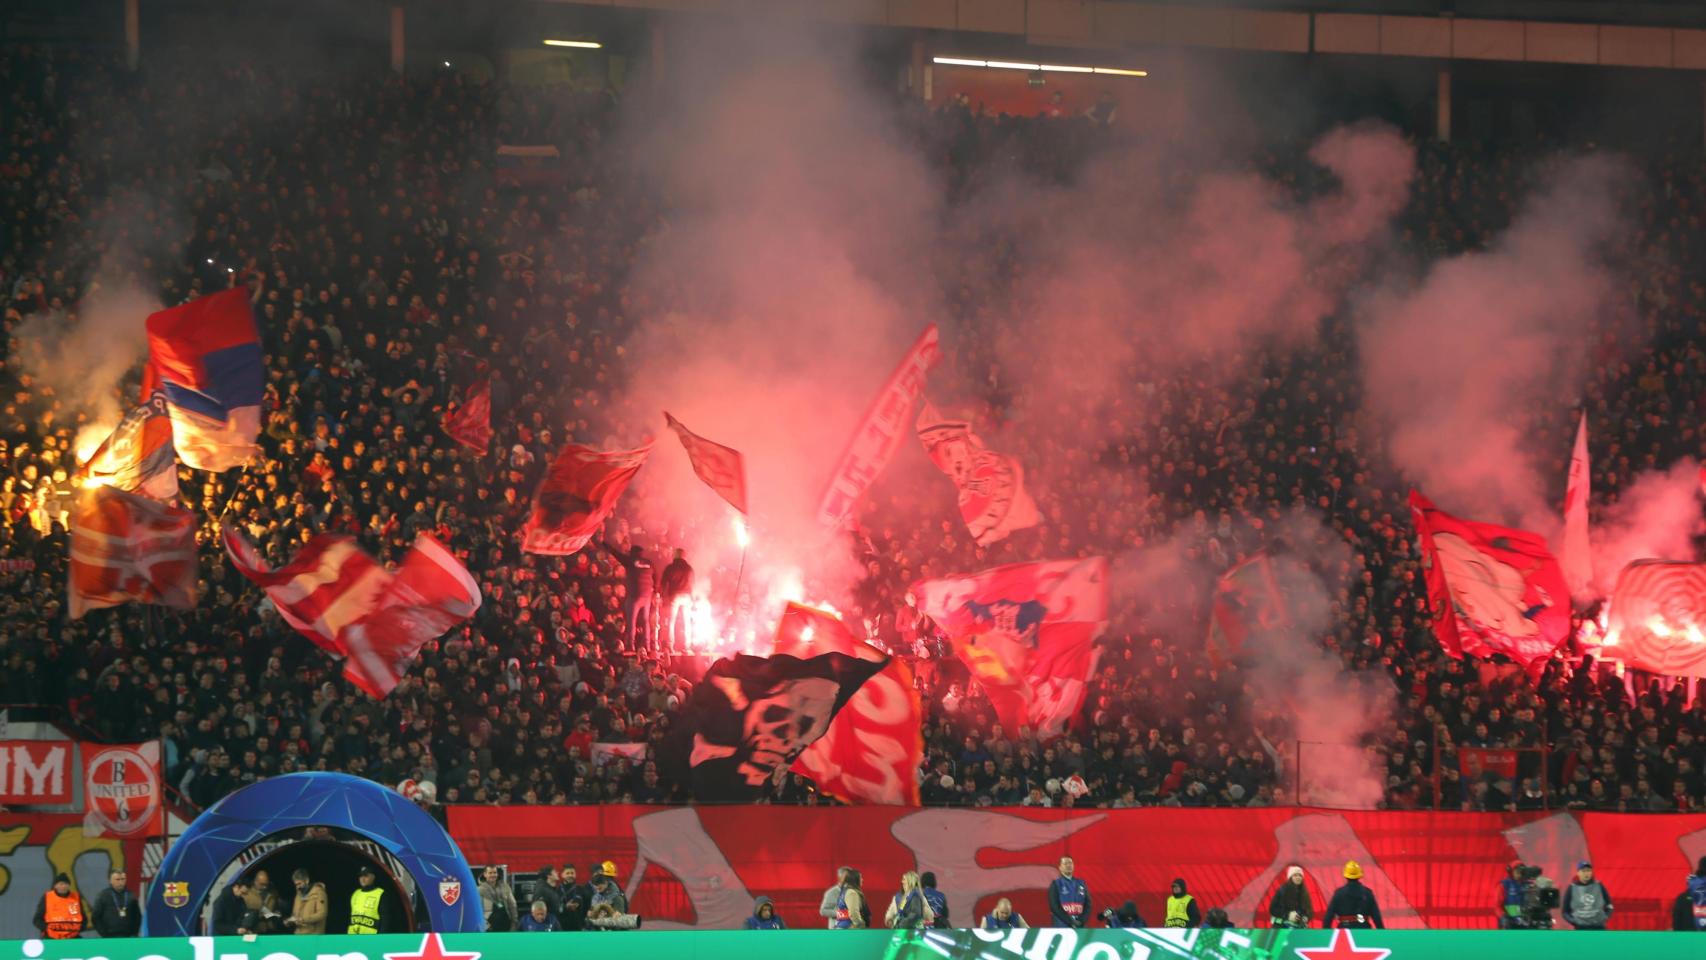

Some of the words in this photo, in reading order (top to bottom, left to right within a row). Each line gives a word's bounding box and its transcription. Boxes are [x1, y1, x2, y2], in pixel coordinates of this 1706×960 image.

[113, 761, 125, 783] B
[94, 784, 150, 798] UNITED
[118, 801, 129, 821] 6
